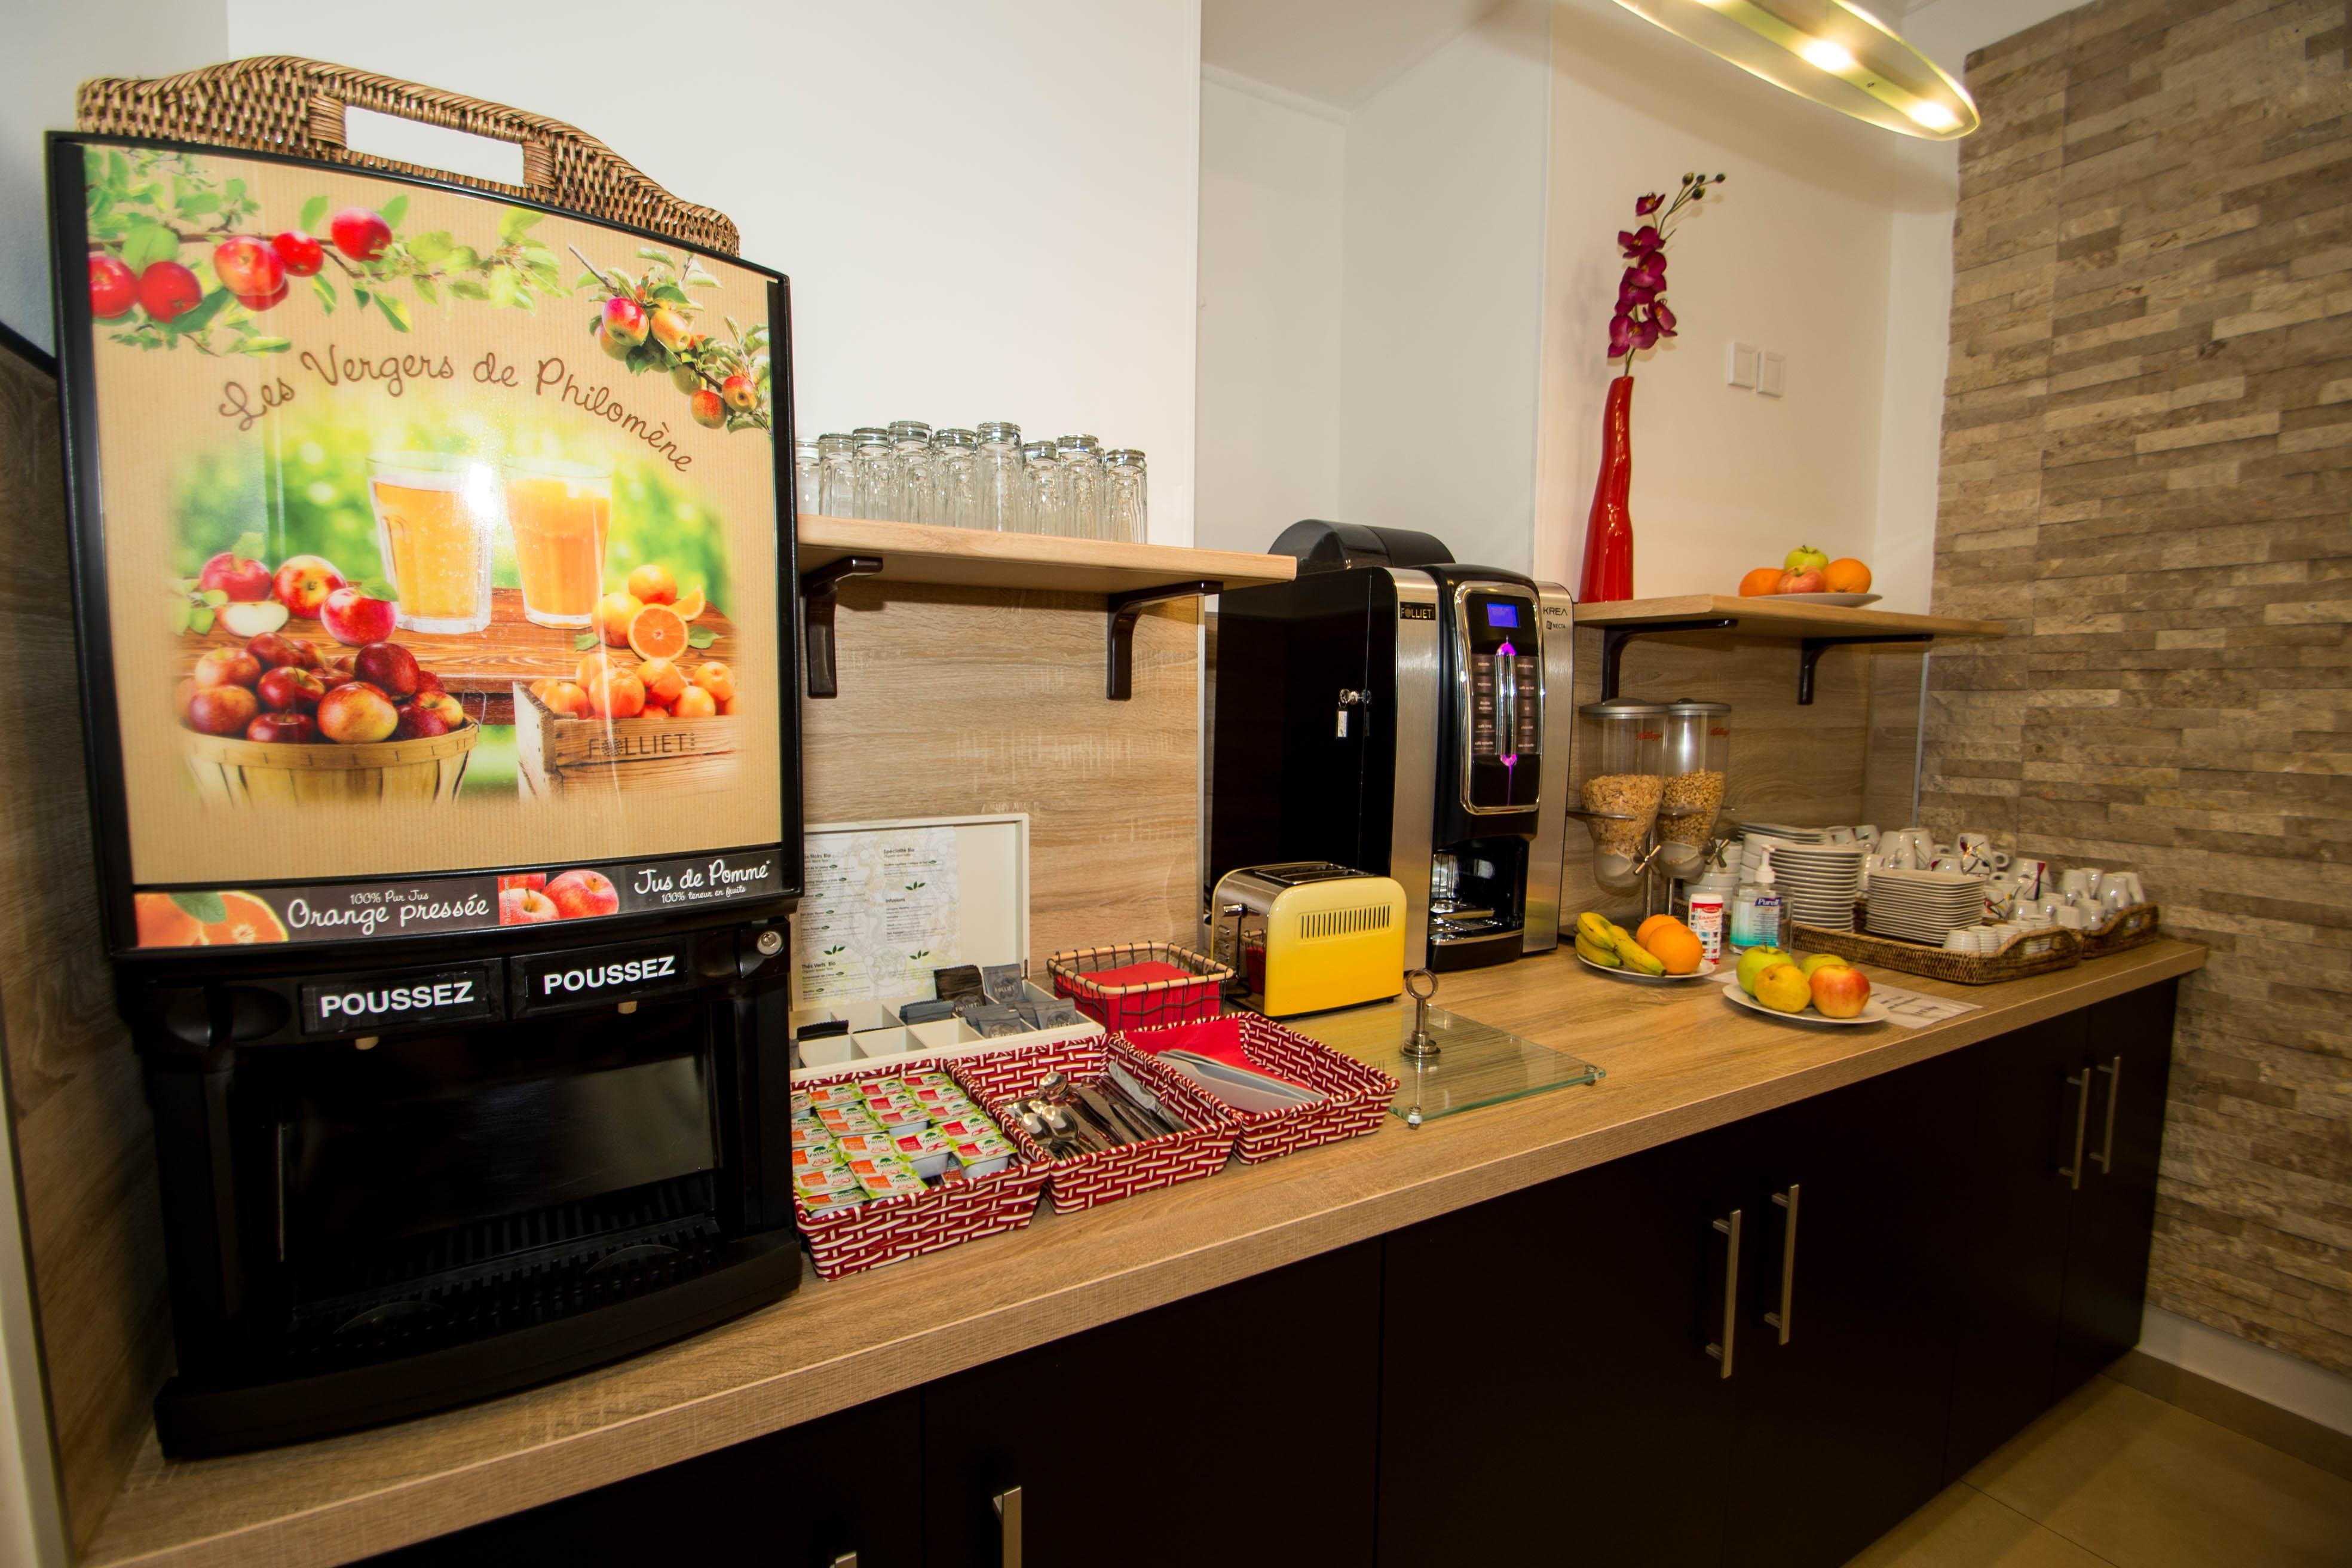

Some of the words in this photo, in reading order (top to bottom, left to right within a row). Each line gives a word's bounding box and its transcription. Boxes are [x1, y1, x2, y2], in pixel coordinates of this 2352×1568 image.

[219, 377, 295, 431] Les
[300, 344, 455, 397] Vergers
[473, 351, 519, 388] de
[535, 357, 694, 473] Philomène
[1401, 608, 1432, 618] FOLLIET
[1543, 607, 1568, 616] KREA
[589, 733, 687, 758] FOLLIET
[634, 869, 673, 894] Jus
[679, 868, 703, 889] de
[350, 892, 381, 905] 100%
[385, 890, 405, 903] Pur
[408, 889, 429, 901] Jus
[662, 892, 685, 904] 100%
[688, 890, 712, 901] teneur
[714, 889, 724, 898] en
[725, 885, 746, 898] fruits
[287, 898, 390, 936] Orange
[400, 894, 490, 927] pressée
[543, 956, 675, 994] POUSSEZ
[321, 981, 474, 1018] POUSSEZ
